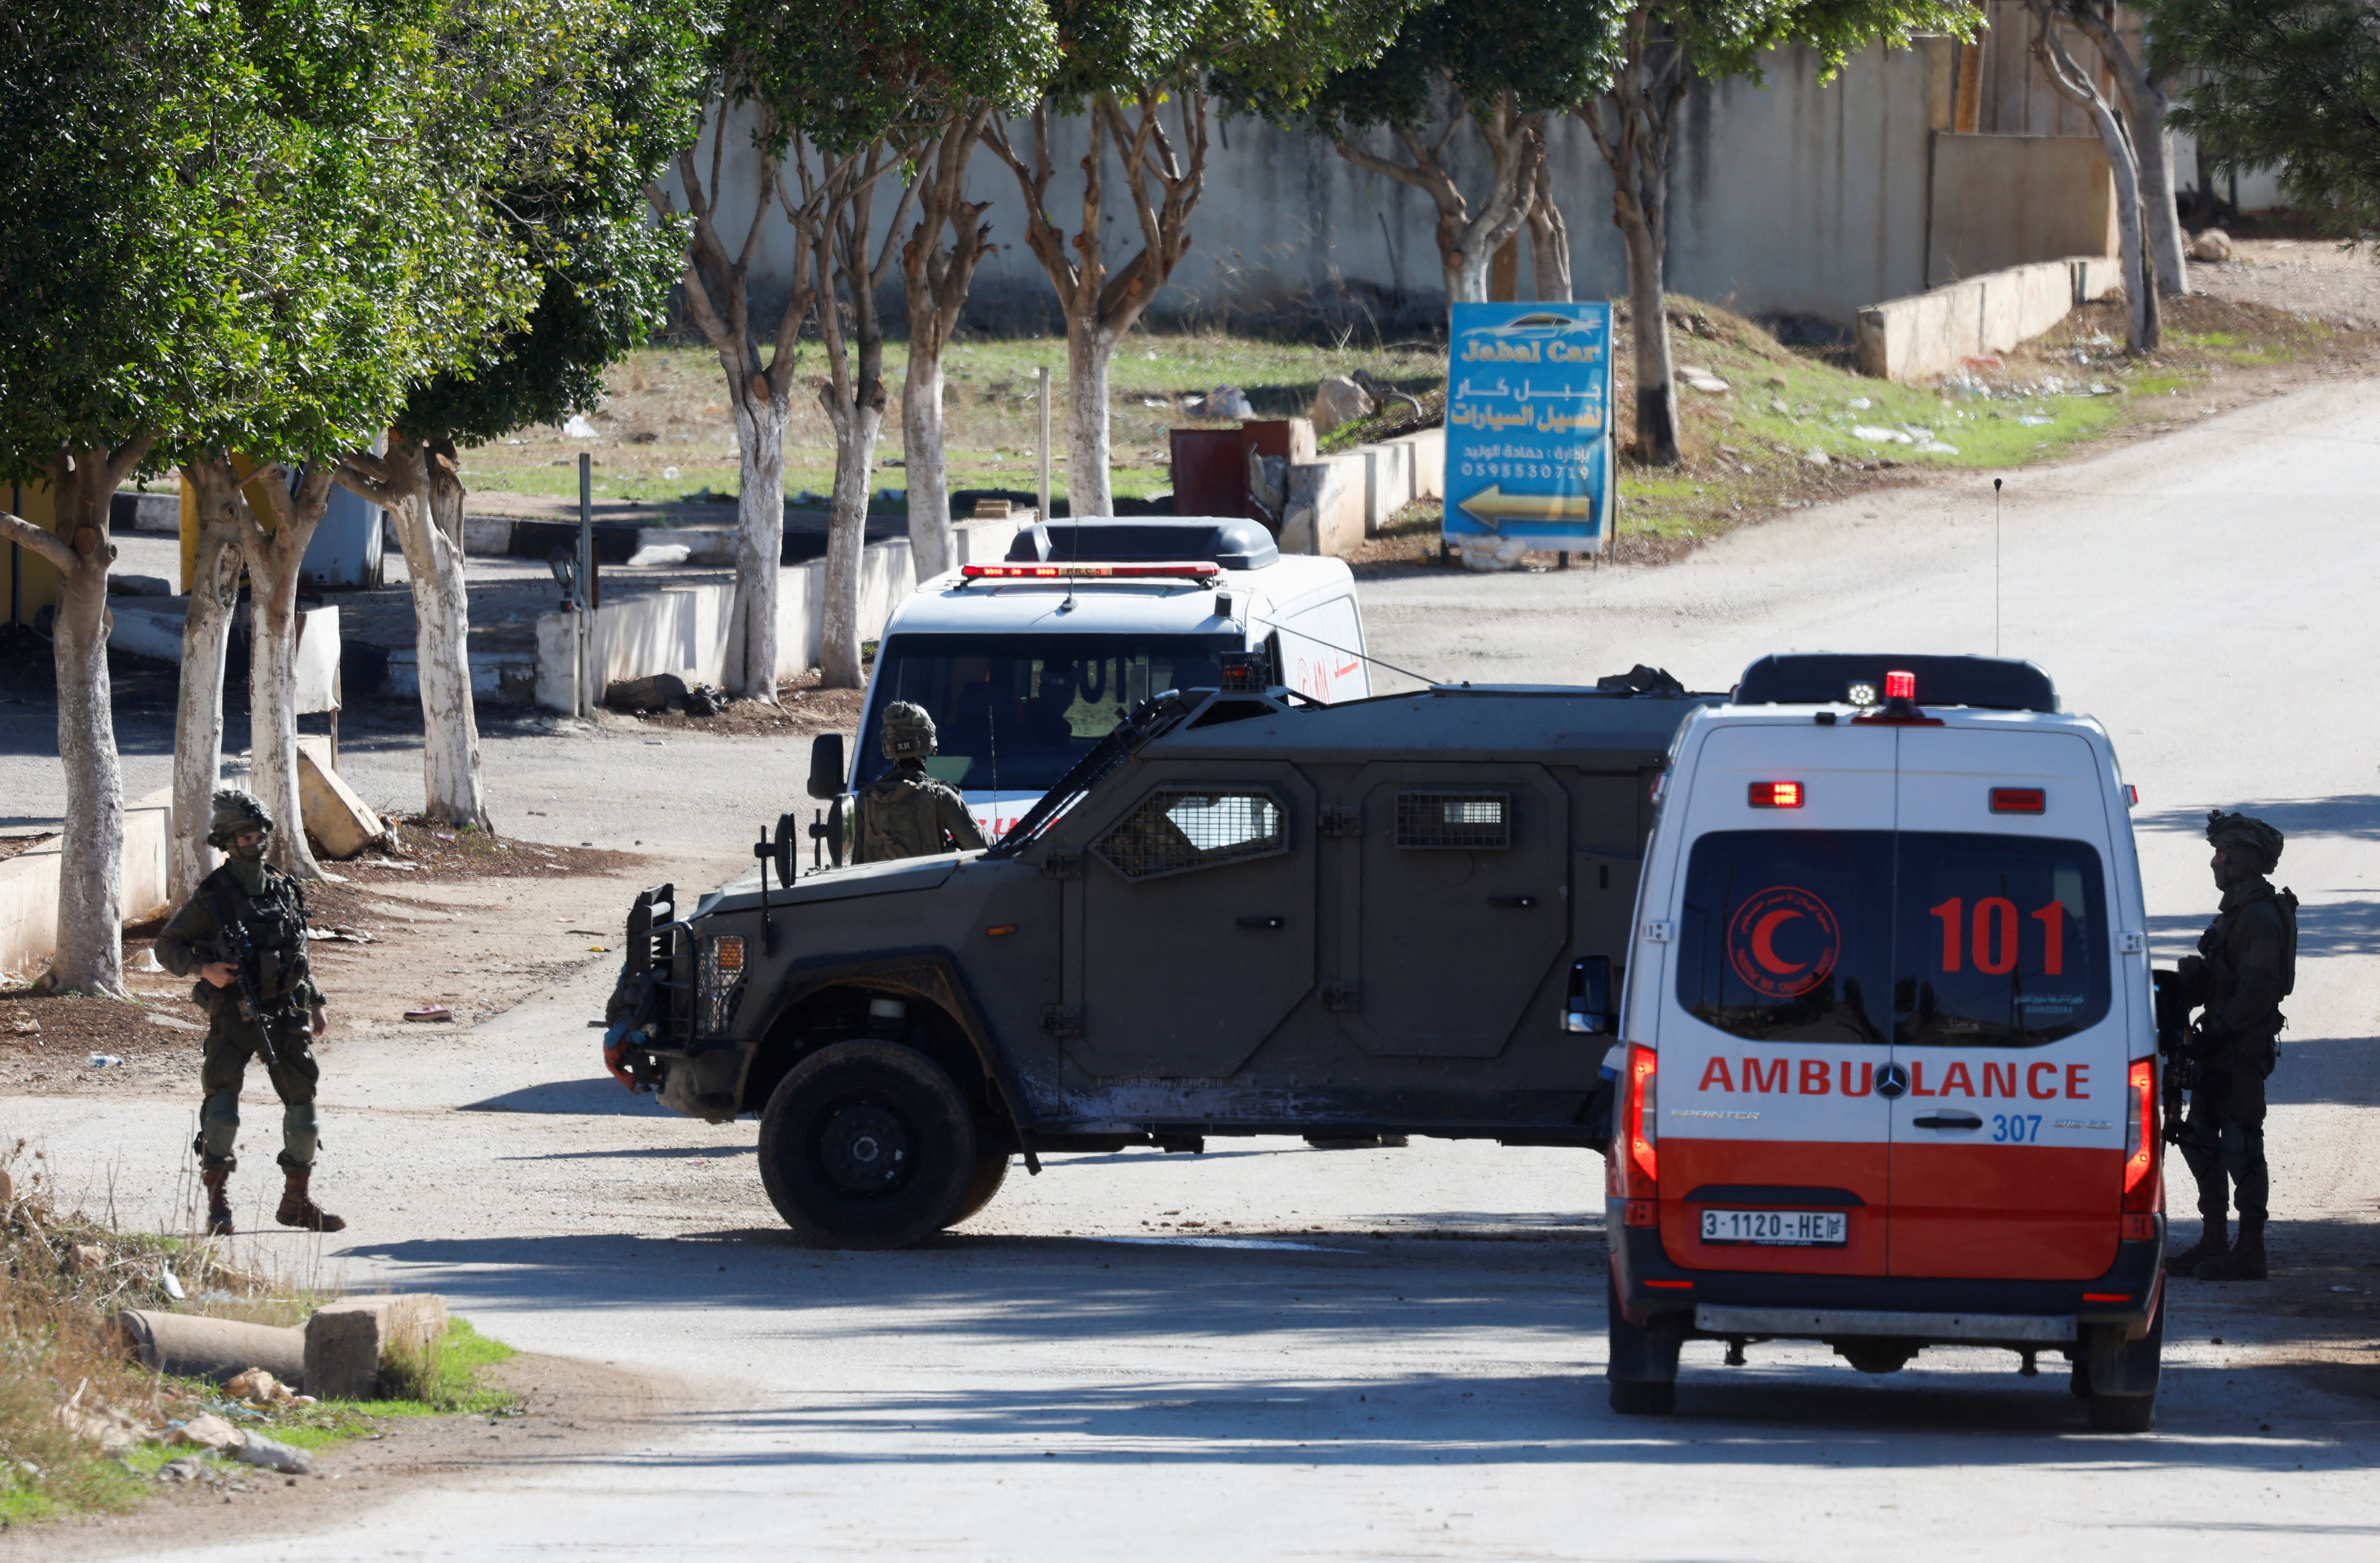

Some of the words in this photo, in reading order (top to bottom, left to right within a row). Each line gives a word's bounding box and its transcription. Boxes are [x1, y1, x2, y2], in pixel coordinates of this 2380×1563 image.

[1461, 340, 1541, 362] Jabal
[1547, 341, 1601, 363] Car
[1455, 376, 1510, 400] كار
[1514, 378, 1602, 402] جبل
[1450, 402, 1534, 431] السيارات
[1537, 404, 1603, 432] لغسيل
[1930, 897, 2063, 975] 101
[1698, 1056, 2090, 1100] AMBULANCE
[1670, 1108, 1761, 1120] SPRINTER
[1992, 1114, 2042, 1142] 307
